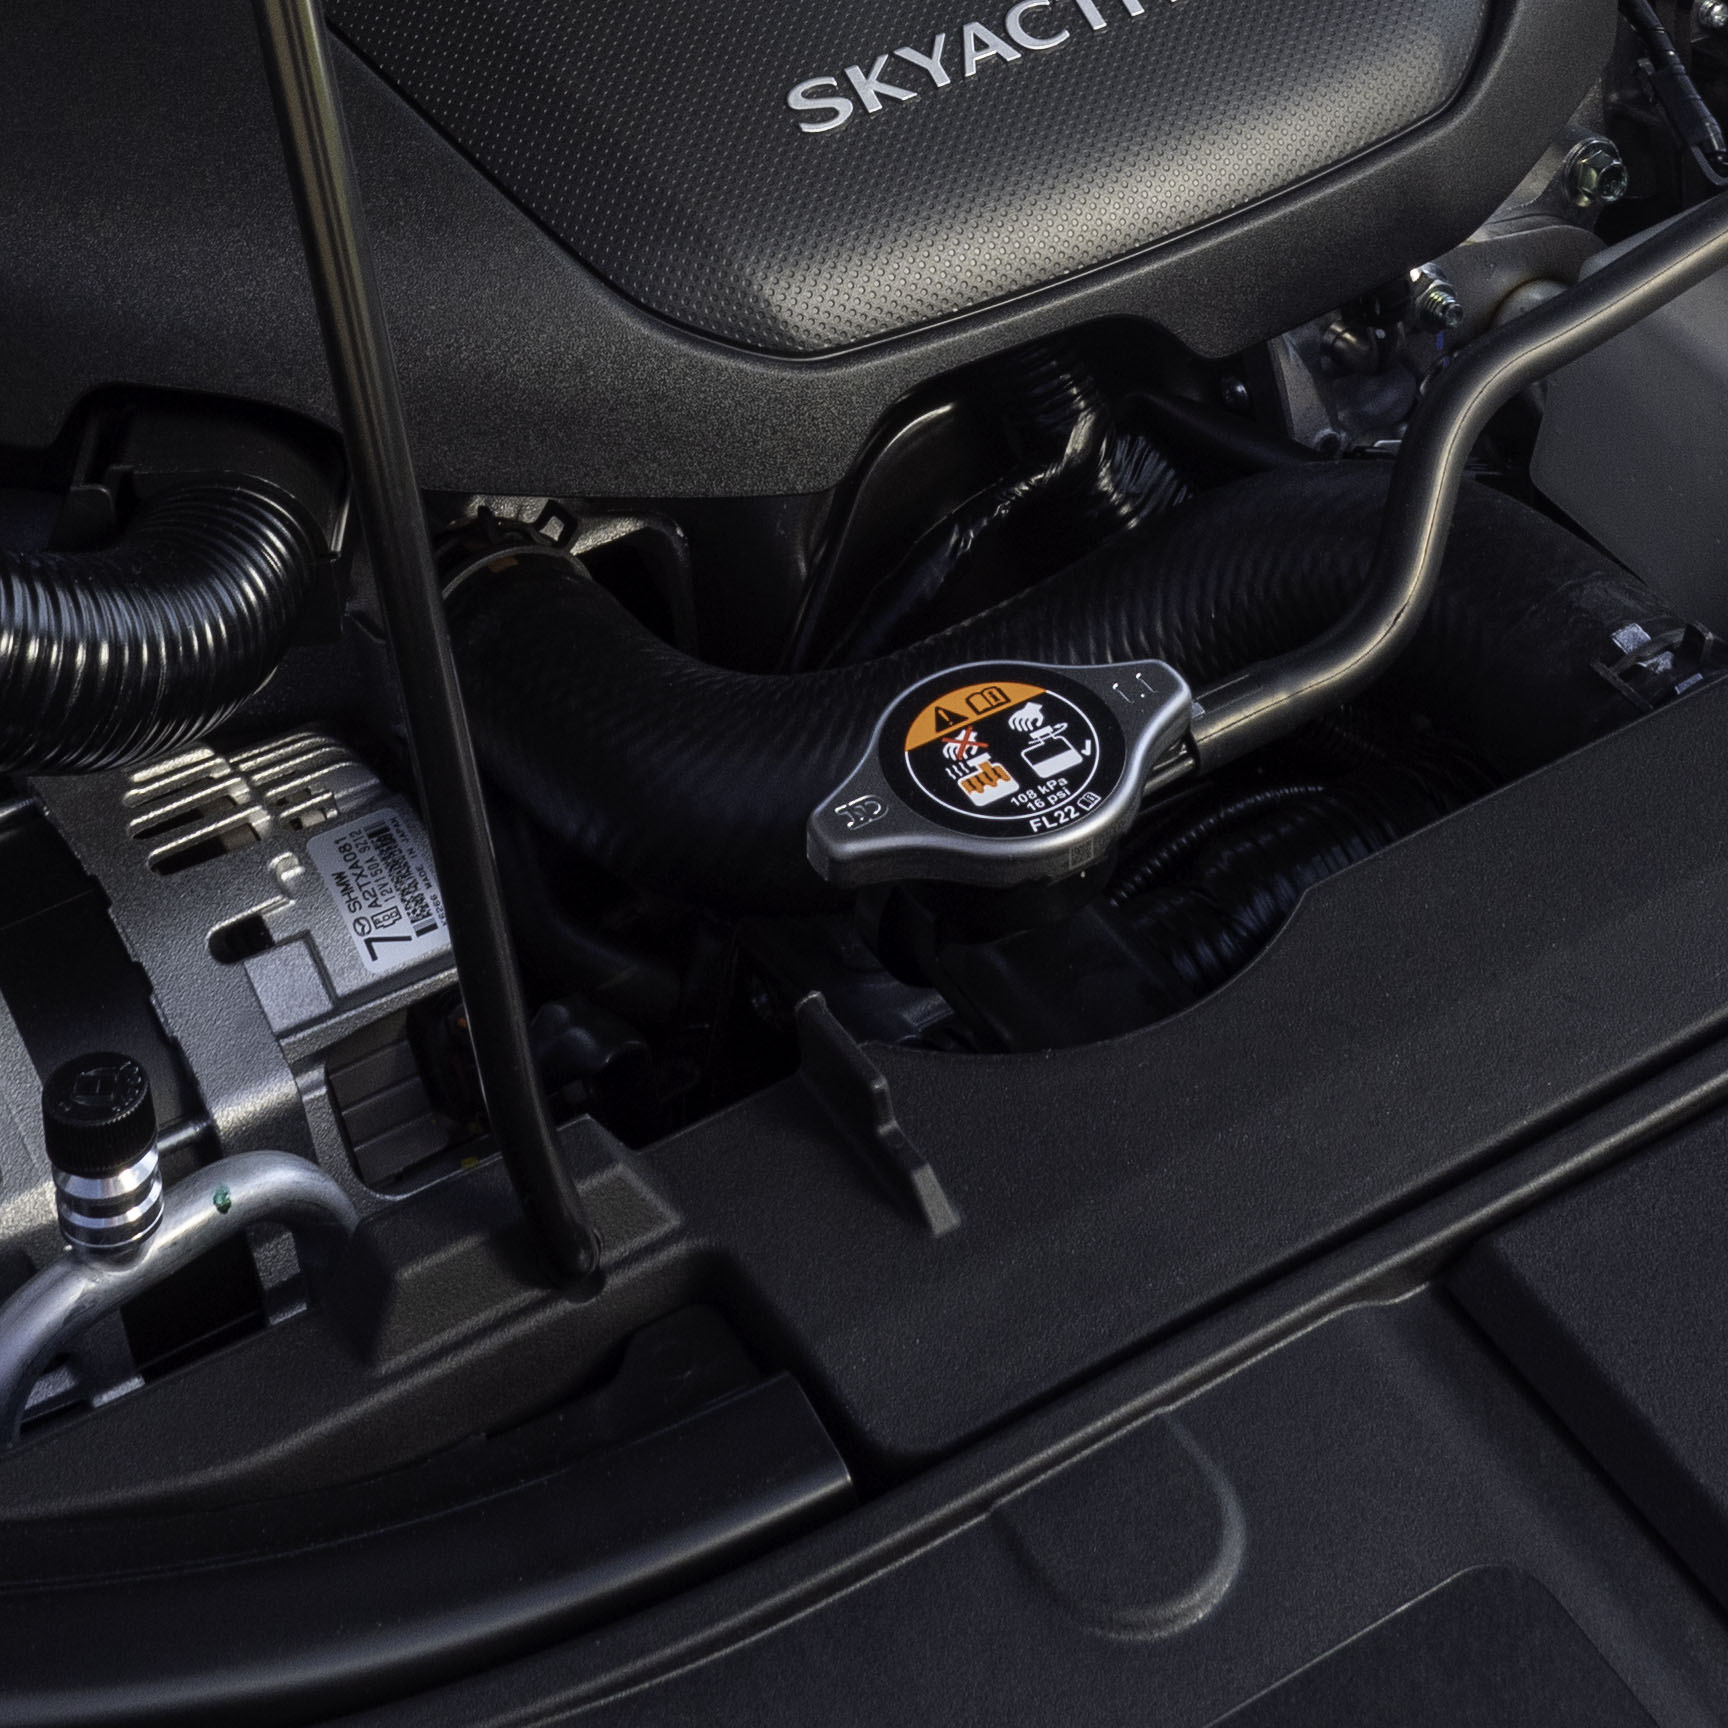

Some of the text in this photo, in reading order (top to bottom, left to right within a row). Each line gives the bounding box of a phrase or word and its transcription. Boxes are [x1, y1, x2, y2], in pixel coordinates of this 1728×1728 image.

[1010, 777, 1069, 807] 108 kPa
[1026, 787, 1072, 811] 16 psi
[390, 815, 411, 844] JAPAN
[1029, 805, 1080, 833] FL22
[406, 846, 418, 860] IN
[334, 837, 382, 910] A2TXA081
[415, 863, 433, 890] MADE
[331, 871, 363, 914] SHMW
[362, 934, 413, 962] 7
